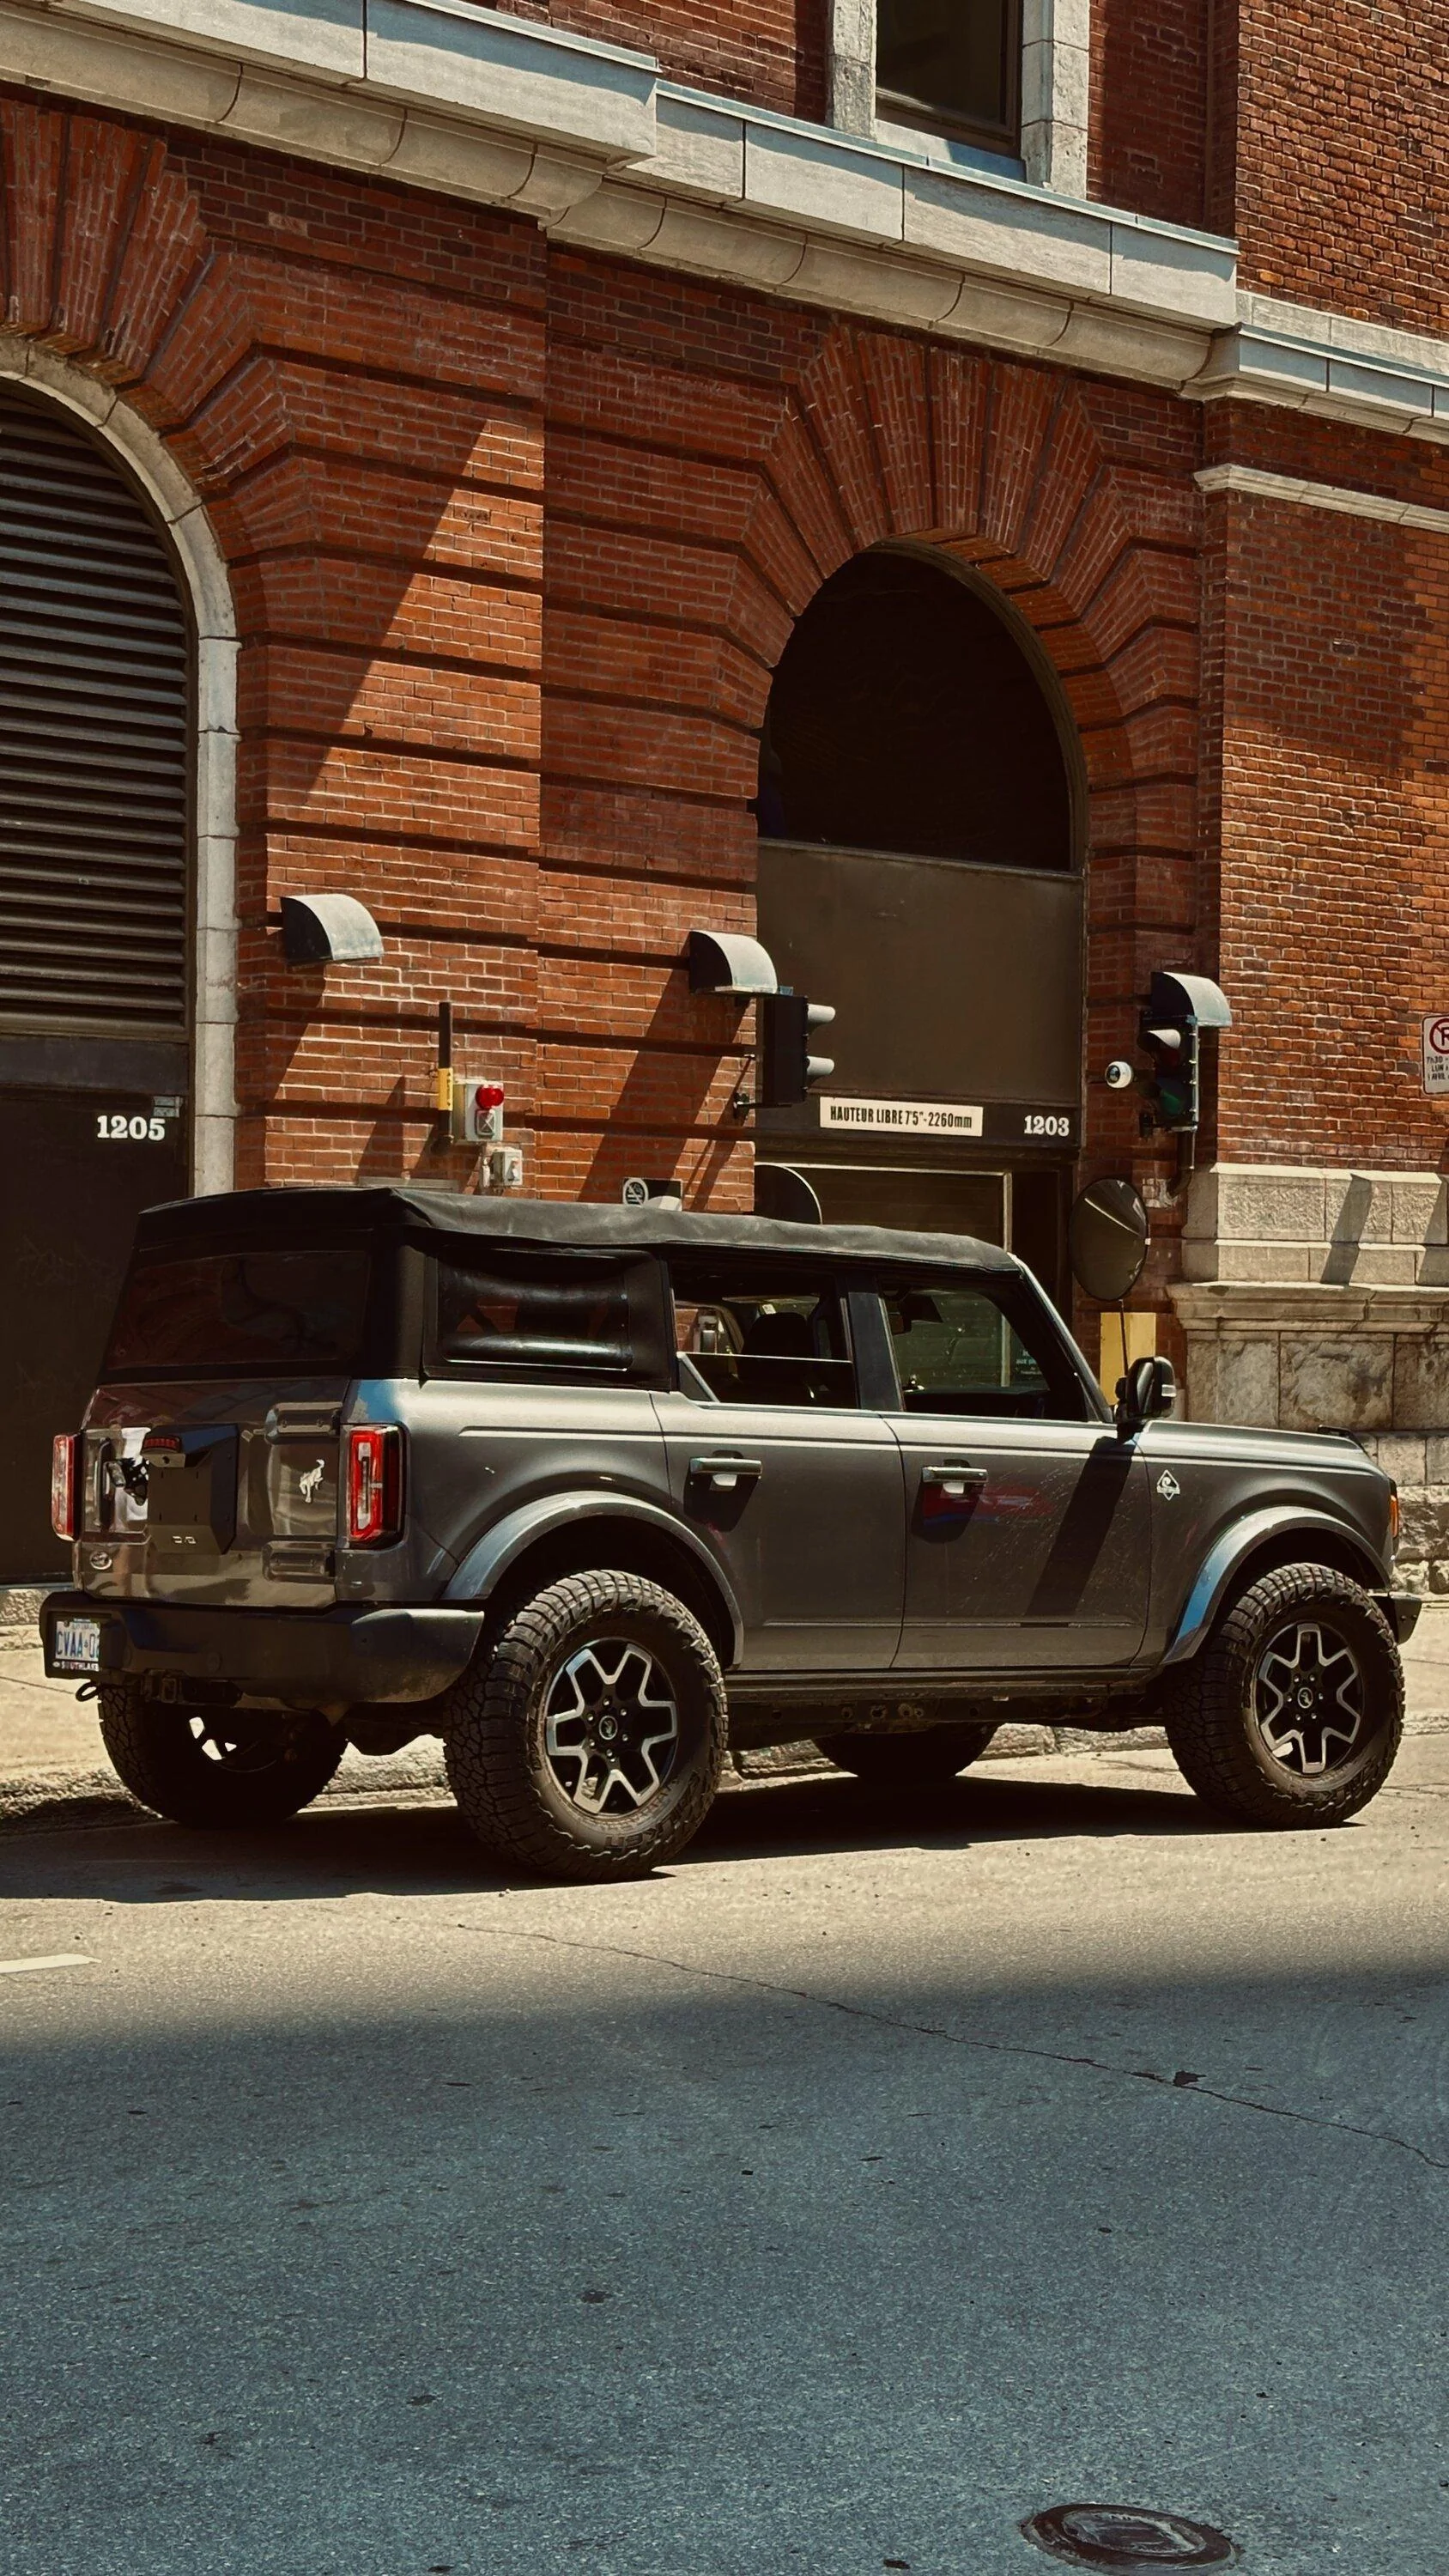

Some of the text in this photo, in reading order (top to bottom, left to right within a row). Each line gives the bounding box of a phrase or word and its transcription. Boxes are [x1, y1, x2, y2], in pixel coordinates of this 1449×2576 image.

[830, 1105, 874, 1122] HAUTEUR
[876, 1109, 903, 1125] LIBRE
[1024, 1115, 1070, 1137] 1203
[97, 1115, 166, 1141] 1205
